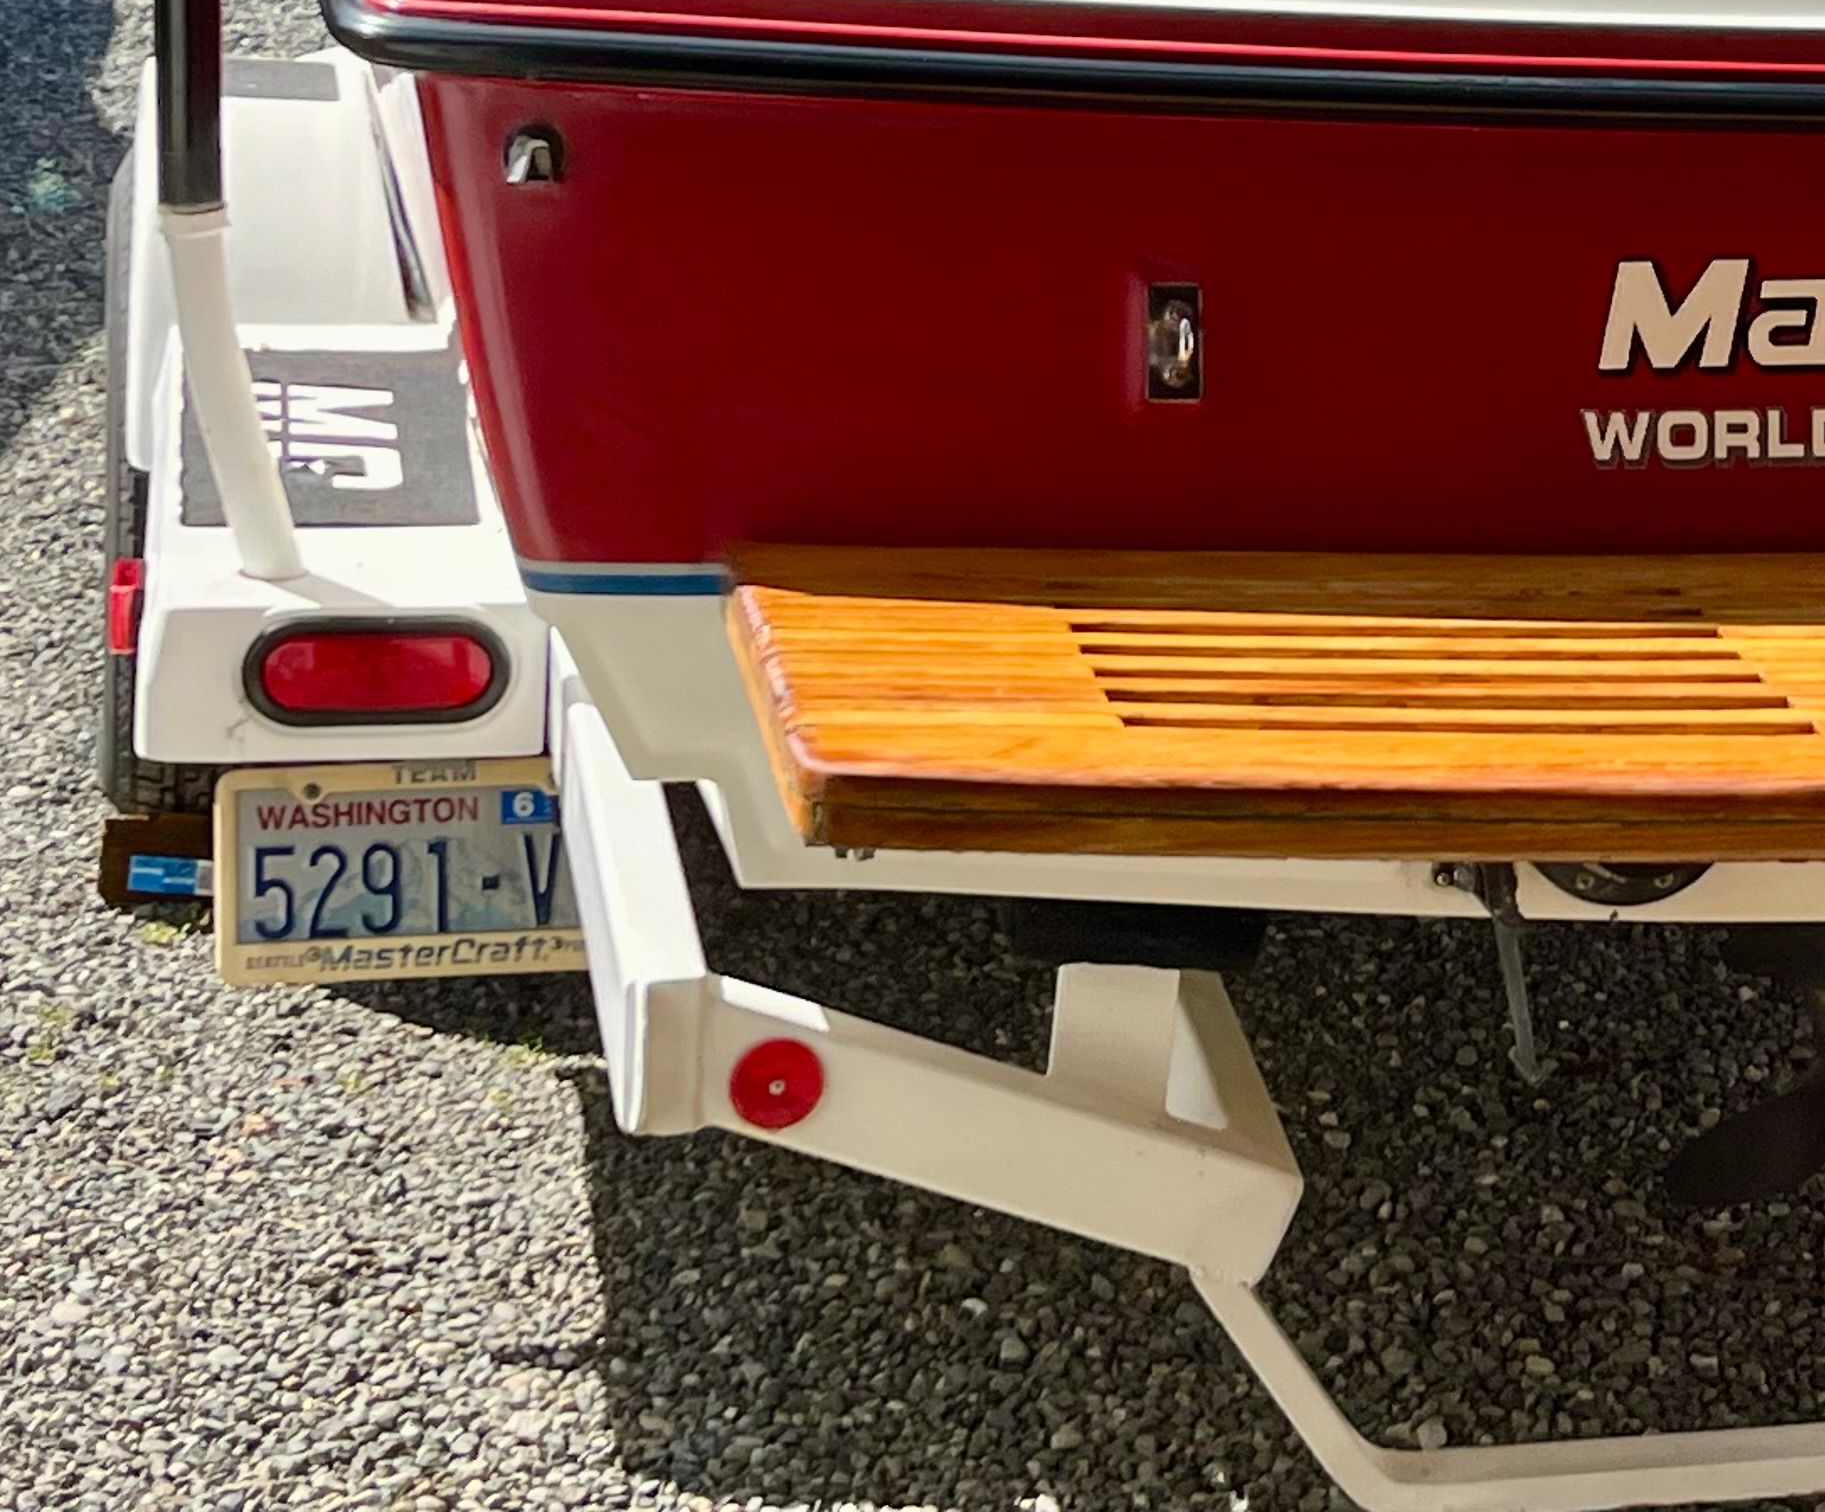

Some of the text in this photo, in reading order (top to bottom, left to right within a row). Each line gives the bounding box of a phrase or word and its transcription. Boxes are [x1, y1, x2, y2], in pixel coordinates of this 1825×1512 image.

[392, 759, 477, 785] TEAM
[256, 791, 536, 831] WASHINGTON 6
